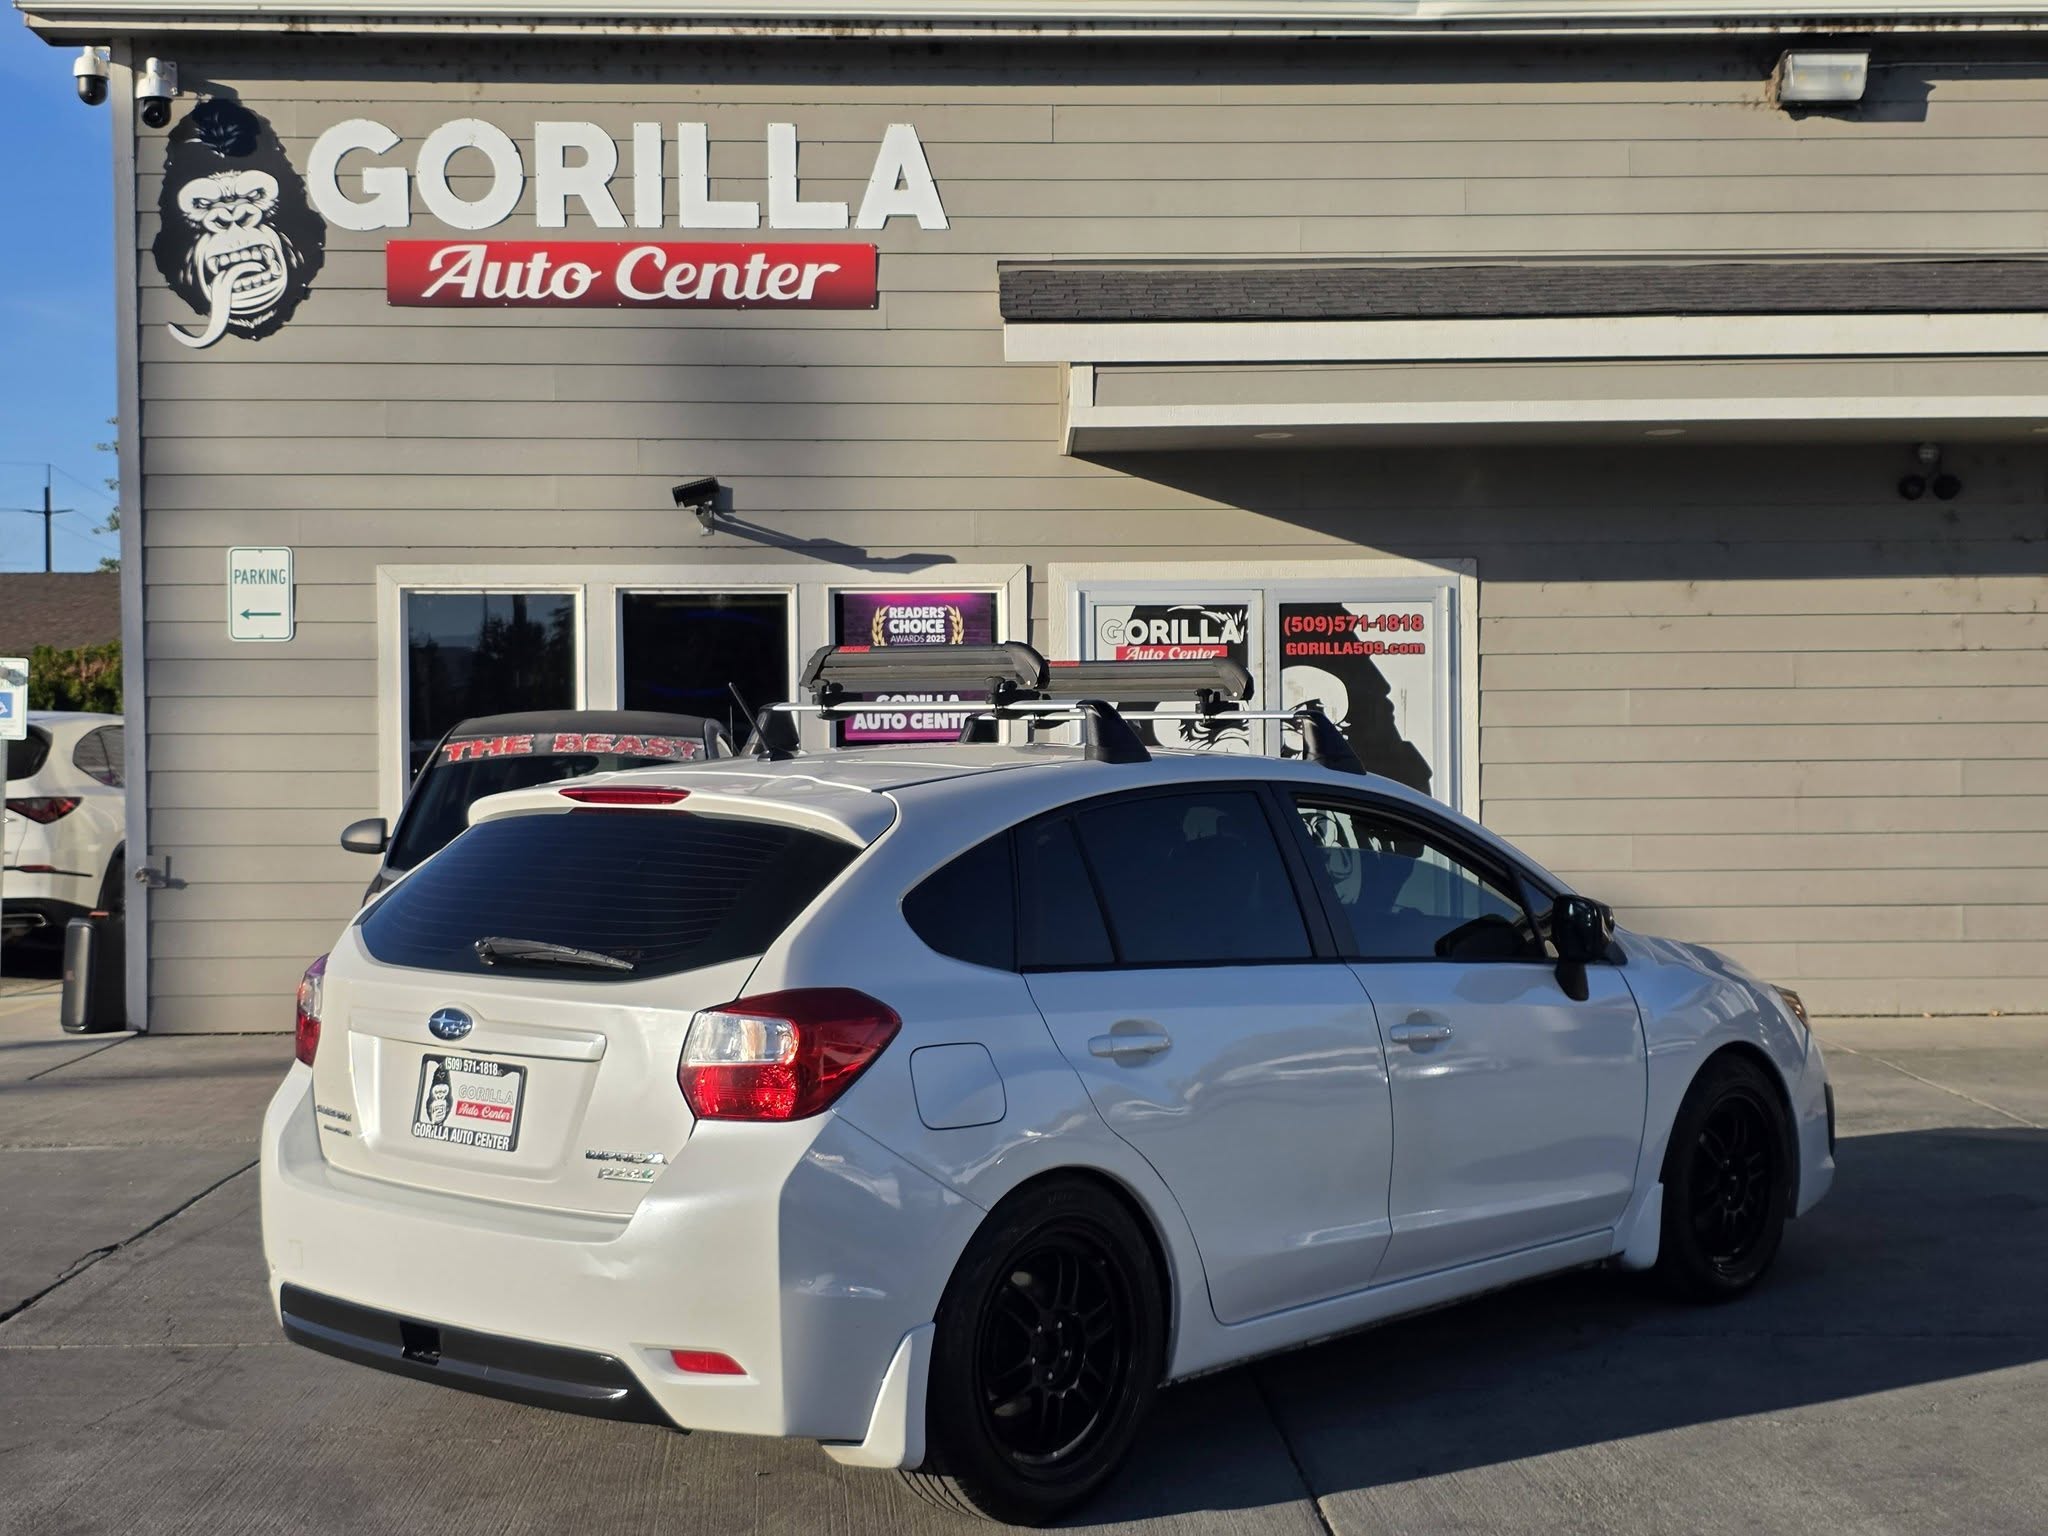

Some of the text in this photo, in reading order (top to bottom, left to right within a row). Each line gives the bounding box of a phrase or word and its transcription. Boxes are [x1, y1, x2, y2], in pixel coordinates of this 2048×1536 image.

[306, 117, 950, 232] GORILLA
[421, 243, 842, 301] Auto Center
[234, 568, 287, 585] PARKING
[888, 619, 945, 634] CHOICE
[1101, 618, 1242, 645] GORILLA
[1284, 614, 1425, 636] (509)571-1818
[890, 634, 946, 643] AWARDS 2025
[1125, 645, 1220, 660] Auto Center
[1285, 641, 1425, 656] GORILLA509.com
[852, 712, 972, 730] AUTO CENT
[442, 733, 705, 762] THE BEAST
[445, 1057, 463, 1072] (509)
[459, 1084, 515, 1105] GORILLA
[458, 1102, 511, 1121] Auto Center
[414, 1122, 510, 1151] GORILLA AUTO CENTER
